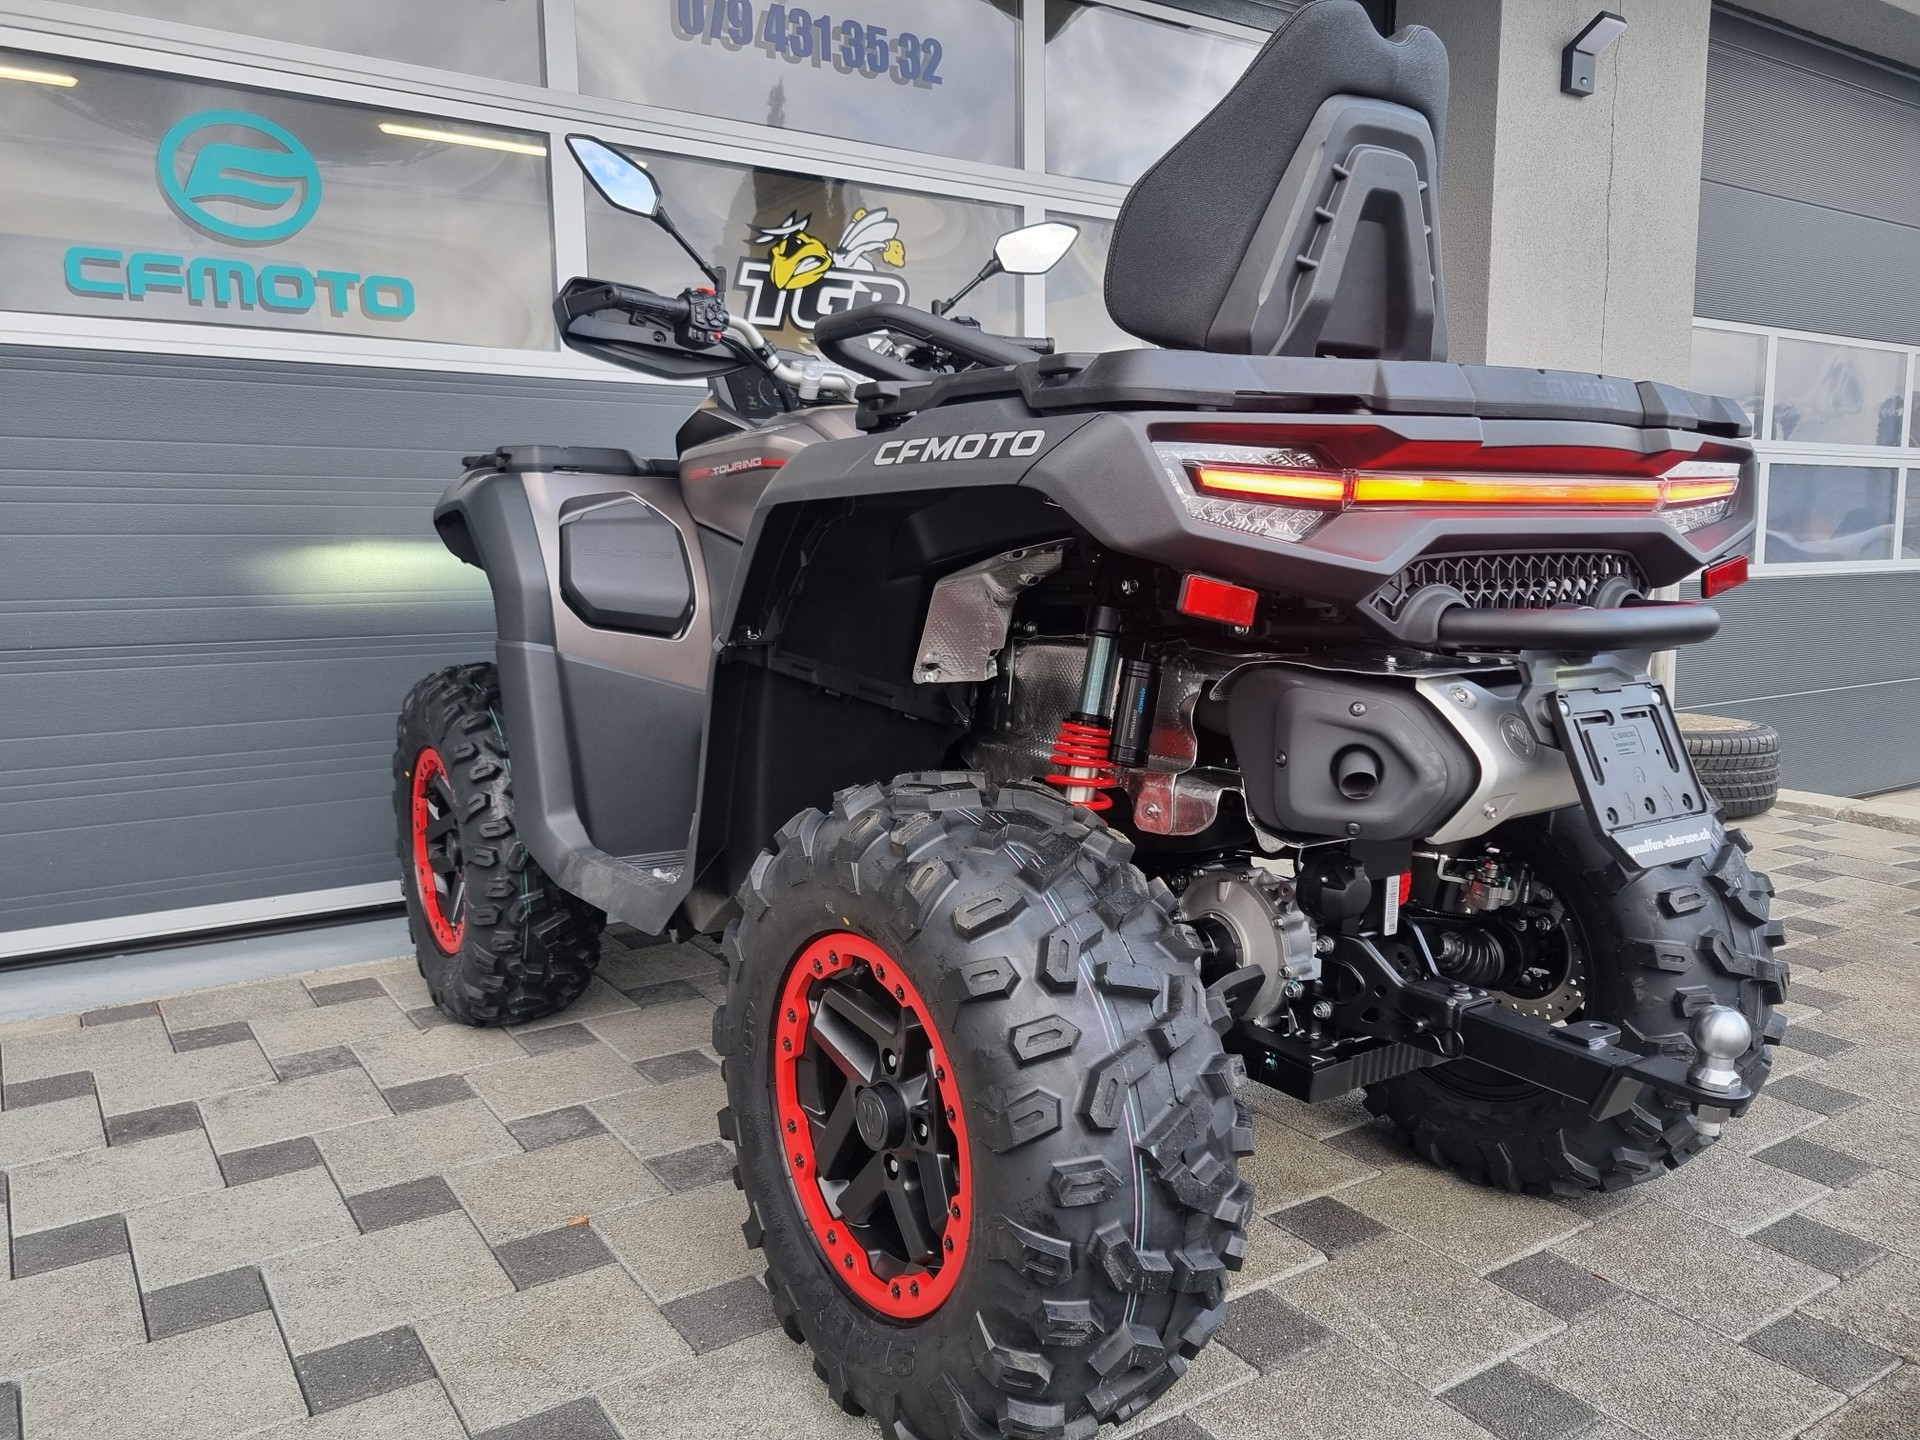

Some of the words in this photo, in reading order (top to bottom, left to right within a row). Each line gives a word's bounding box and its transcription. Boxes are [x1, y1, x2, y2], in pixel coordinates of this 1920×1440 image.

[677, 0, 753, 46] 079
[64, 246, 416, 317] CFMOTO
[873, 429, 1046, 466] CFMOTO
[712, 457, 762, 476] TOURING
[1627, 828, 1711, 858] quadfun-obersee.ch
